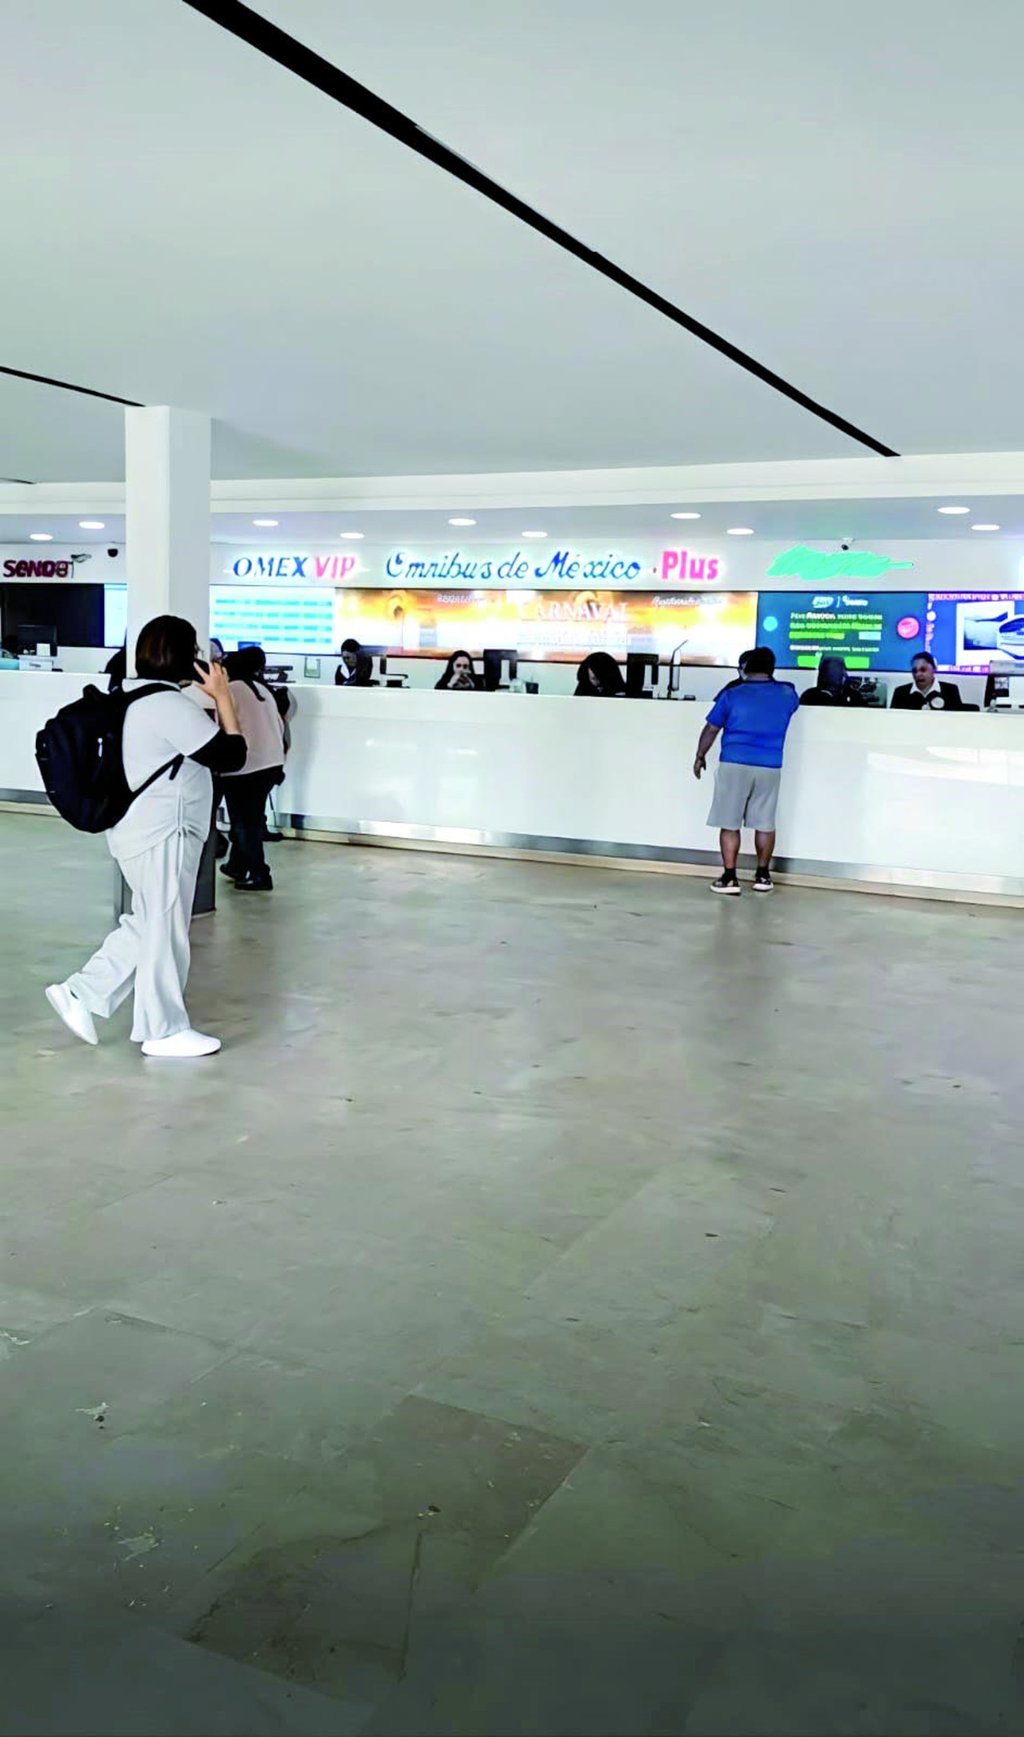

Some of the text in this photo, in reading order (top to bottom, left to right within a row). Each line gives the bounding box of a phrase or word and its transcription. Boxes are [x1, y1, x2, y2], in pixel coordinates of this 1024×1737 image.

[233, 555, 355, 578] OMEX VIP
[386, 550, 718, 579] Omnibus de México Plus
